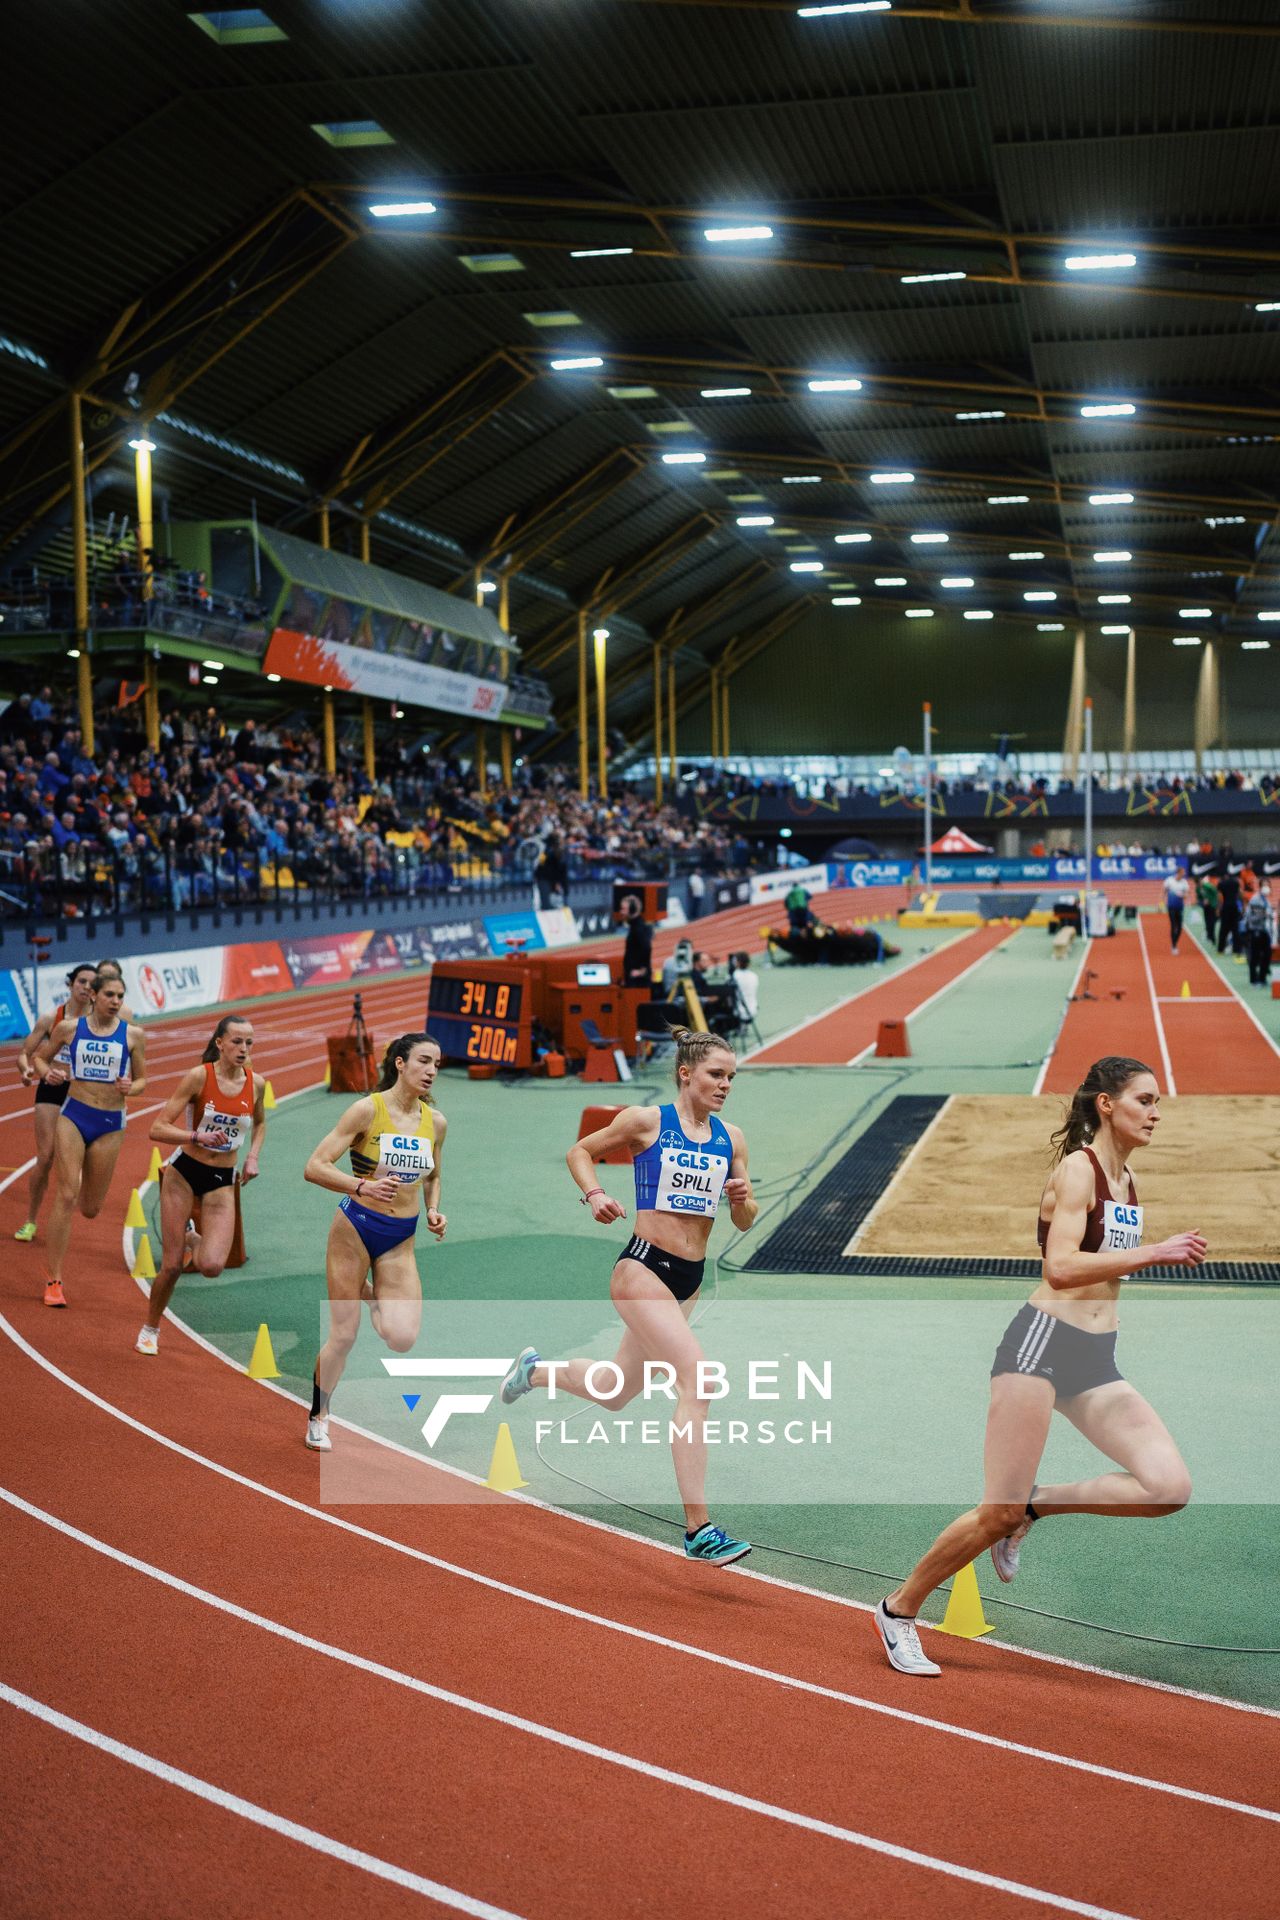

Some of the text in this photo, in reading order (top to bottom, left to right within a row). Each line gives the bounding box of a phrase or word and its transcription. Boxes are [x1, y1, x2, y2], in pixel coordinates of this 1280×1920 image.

[460, 981, 510, 1018] 34.8
[82, 1053, 115, 1067] WOLF
[205, 1123, 240, 1138] HAS
[384, 1152, 431, 1170] TORTELL
[671, 1172, 712, 1192] SPILL
